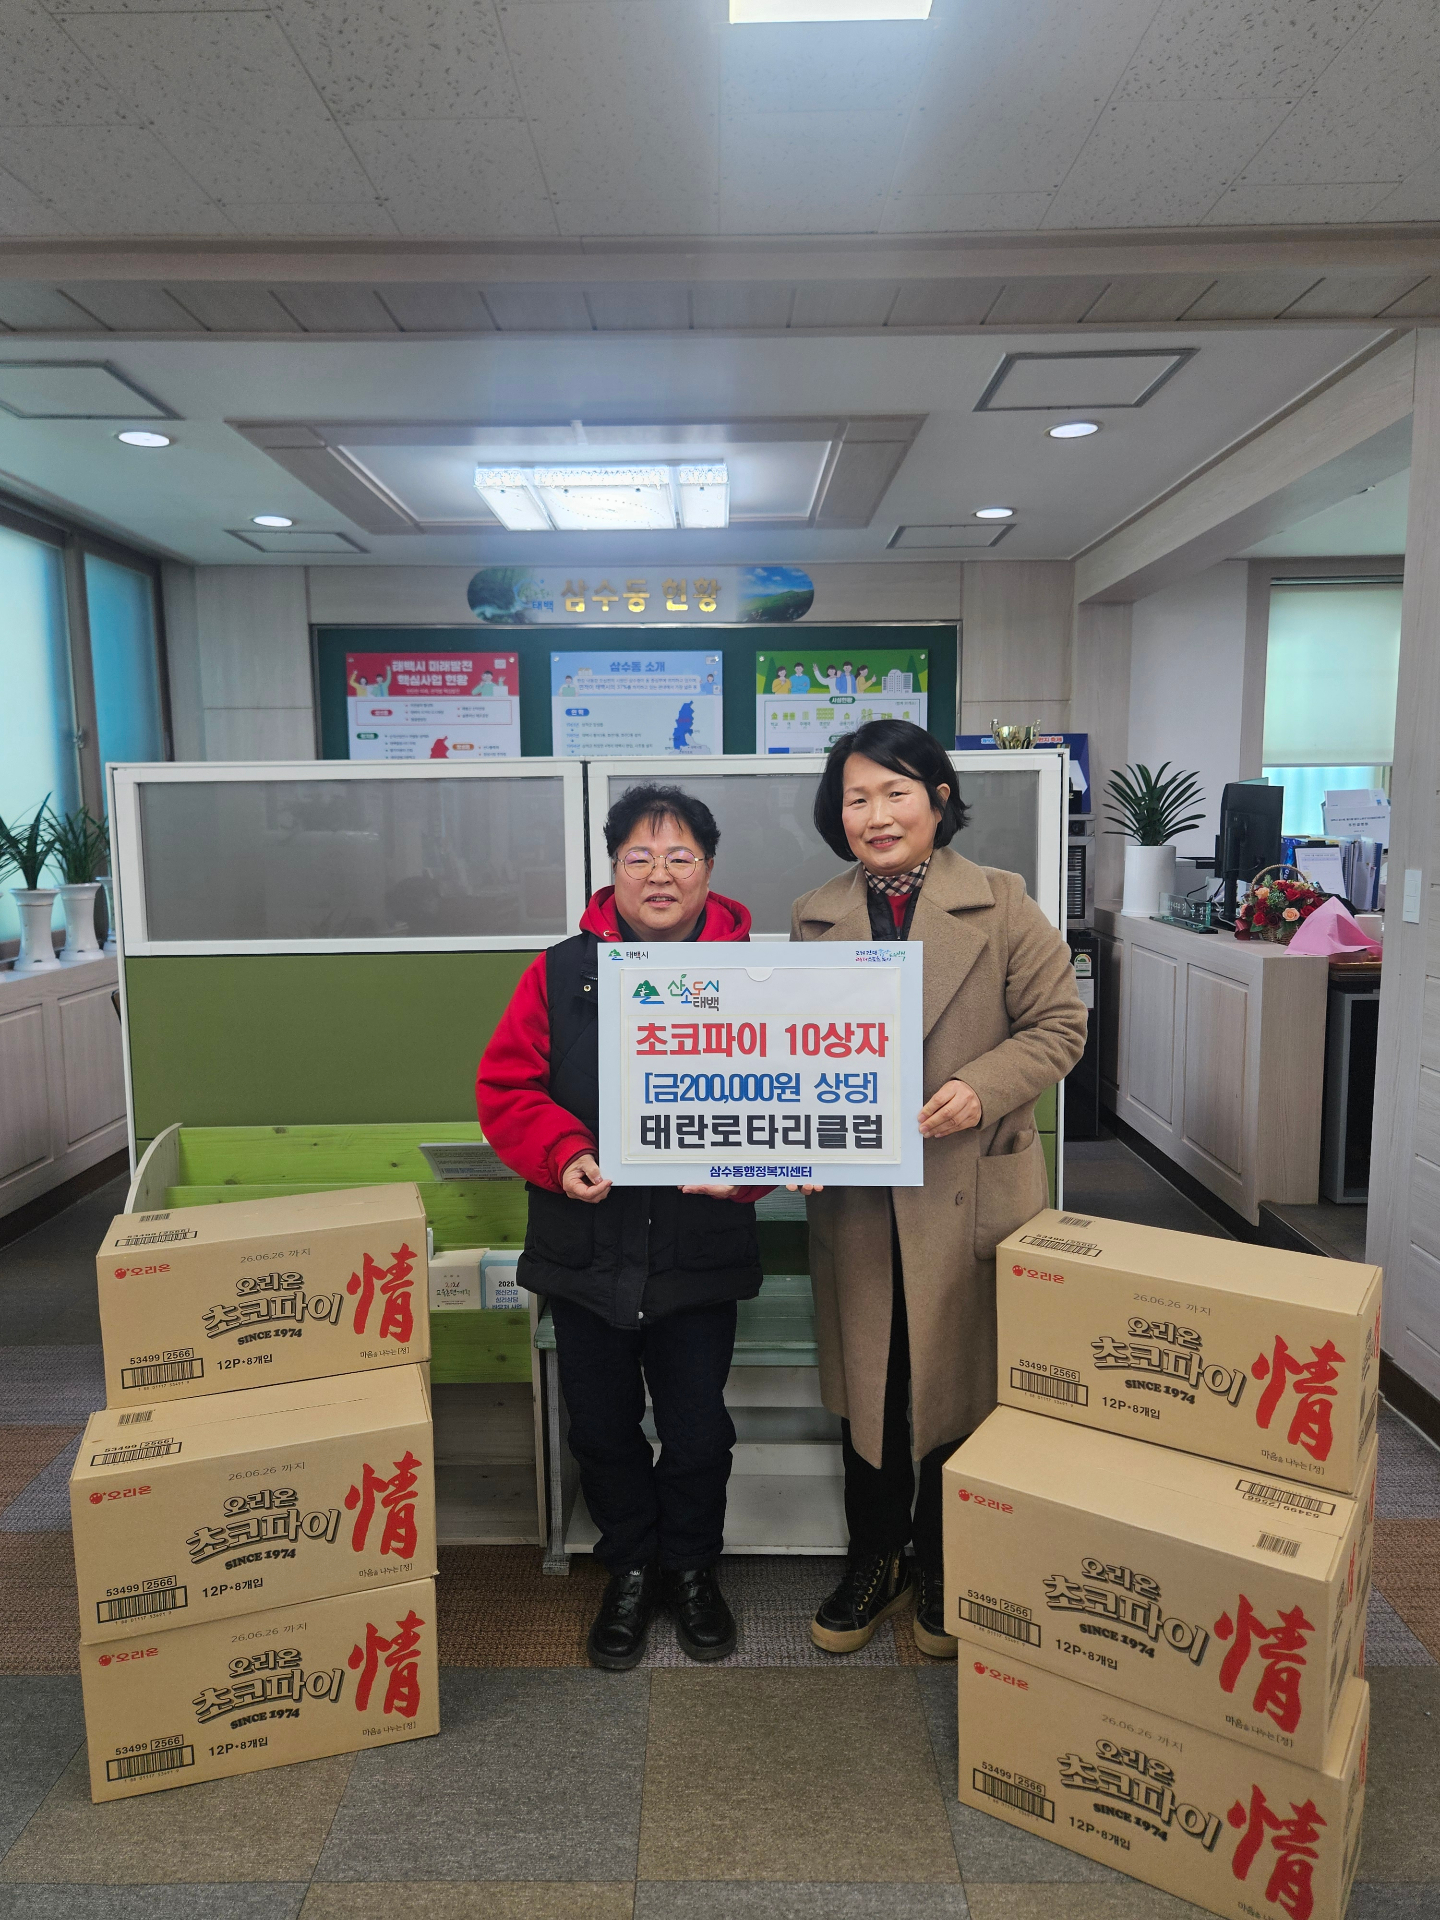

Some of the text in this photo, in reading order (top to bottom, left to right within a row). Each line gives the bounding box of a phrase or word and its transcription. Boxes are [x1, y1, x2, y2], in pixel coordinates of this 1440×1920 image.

[532, 601, 554, 612] 태백
[561, 577, 721, 613] 삼수동 현황
[392, 660, 473, 672] 태백시 미래발전
[609, 661, 666, 673] 삼수동 소개
[397, 674, 469, 686] 핵심사업 현황
[625, 950, 649, 960] 태백시
[668, 974, 719, 1004] 산소도시
[692, 996, 720, 1012] 태백
[636, 1022, 889, 1058] 초코파이 10상자
[644, 1072, 878, 1104] [금200,000원 상당]
[640, 1114, 883, 1150] 태란로타리클럽
[709, 1166, 812, 1178] 삼수동행정복지센터
[240, 1248, 311, 1264] 26.06.26 까지
[130, 1263, 171, 1277] 오리온
[1027, 1268, 1066, 1285] 오리온
[236, 1272, 305, 1297] 오리온
[346, 1242, 418, 1344] 情
[498, 1280, 515, 1288] 2026
[202, 1291, 344, 1340] 초코파이
[1133, 1293, 1212, 1317] 26.06.26 까지
[237, 1328, 303, 1346] SINCE 1974
[1128, 1316, 1203, 1349] 오리온
[130, 1349, 191, 1366] 53499 2566
[1019, 1358, 1077, 1380] 53499 2566
[1091, 1336, 1247, 1408] 초코파이
[1124, 1378, 1196, 1405] SINCE 1974
[1251, 1334, 1347, 1462] 情
[228, 1462, 306, 1481] 26.06.26 까지
[106, 1486, 152, 1501] 오리온
[223, 1487, 299, 1518] 오리온
[344, 1450, 423, 1560] 情
[974, 1495, 1014, 1515] 오리온
[1247, 1495, 1320, 1519] 53499 2566
[186, 1508, 341, 1565] 초코파이
[224, 1548, 297, 1570] SINCE 1974
[106, 1577, 174, 1597] 53499 2566
[1081, 1557, 1162, 1598] 오리온
[966, 1590, 1029, 1618] 53499 2566
[231, 1622, 308, 1643] 26.06.26 까지
[1042, 1574, 1209, 1667] 초코파이
[1079, 1622, 1156, 1659] SINCE 1974
[115, 1648, 159, 1663] 오리온
[228, 1648, 303, 1679] 오리온
[348, 1610, 426, 1719] 情
[1213, 1594, 1317, 1735] 情
[990, 1668, 1030, 1692] 오리온
[192, 1668, 345, 1725] 초코파이
[230, 1708, 301, 1730] SINCE 1974
[115, 1736, 182, 1756] 53499 2566
[1101, 1714, 1184, 1753] 26.06.26 까지
[1096, 1738, 1176, 1784] 오리온
[981, 1761, 1043, 1794] 53499 2566
[1057, 1754, 1223, 1853] 초코파이
[1093, 1802, 1168, 1842] SINCE 1974
[1227, 1784, 1328, 1920] 情
